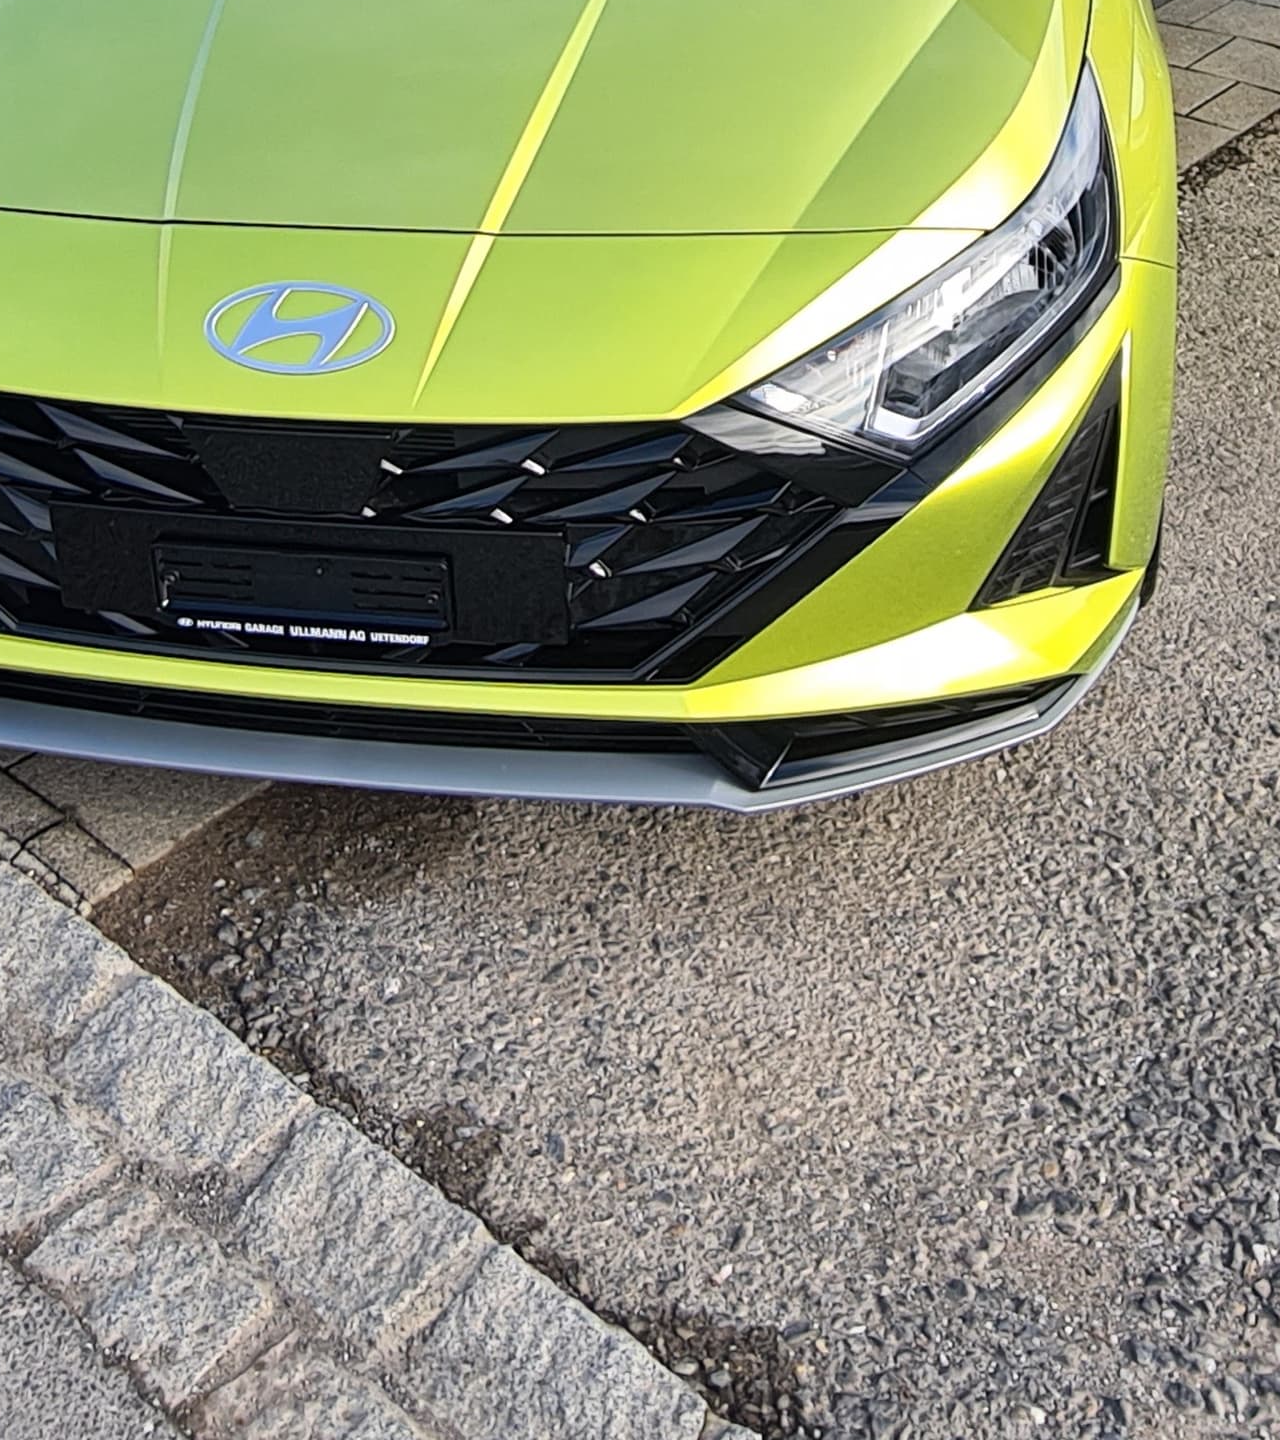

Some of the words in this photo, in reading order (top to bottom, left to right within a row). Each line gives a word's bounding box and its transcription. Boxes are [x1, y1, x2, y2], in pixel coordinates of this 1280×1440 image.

[245, 622, 284, 635] GARAGE
[289, 625, 347, 641] ULLMANN
[349, 630, 366, 642] AG
[370, 631, 430, 645] UETENDORF
